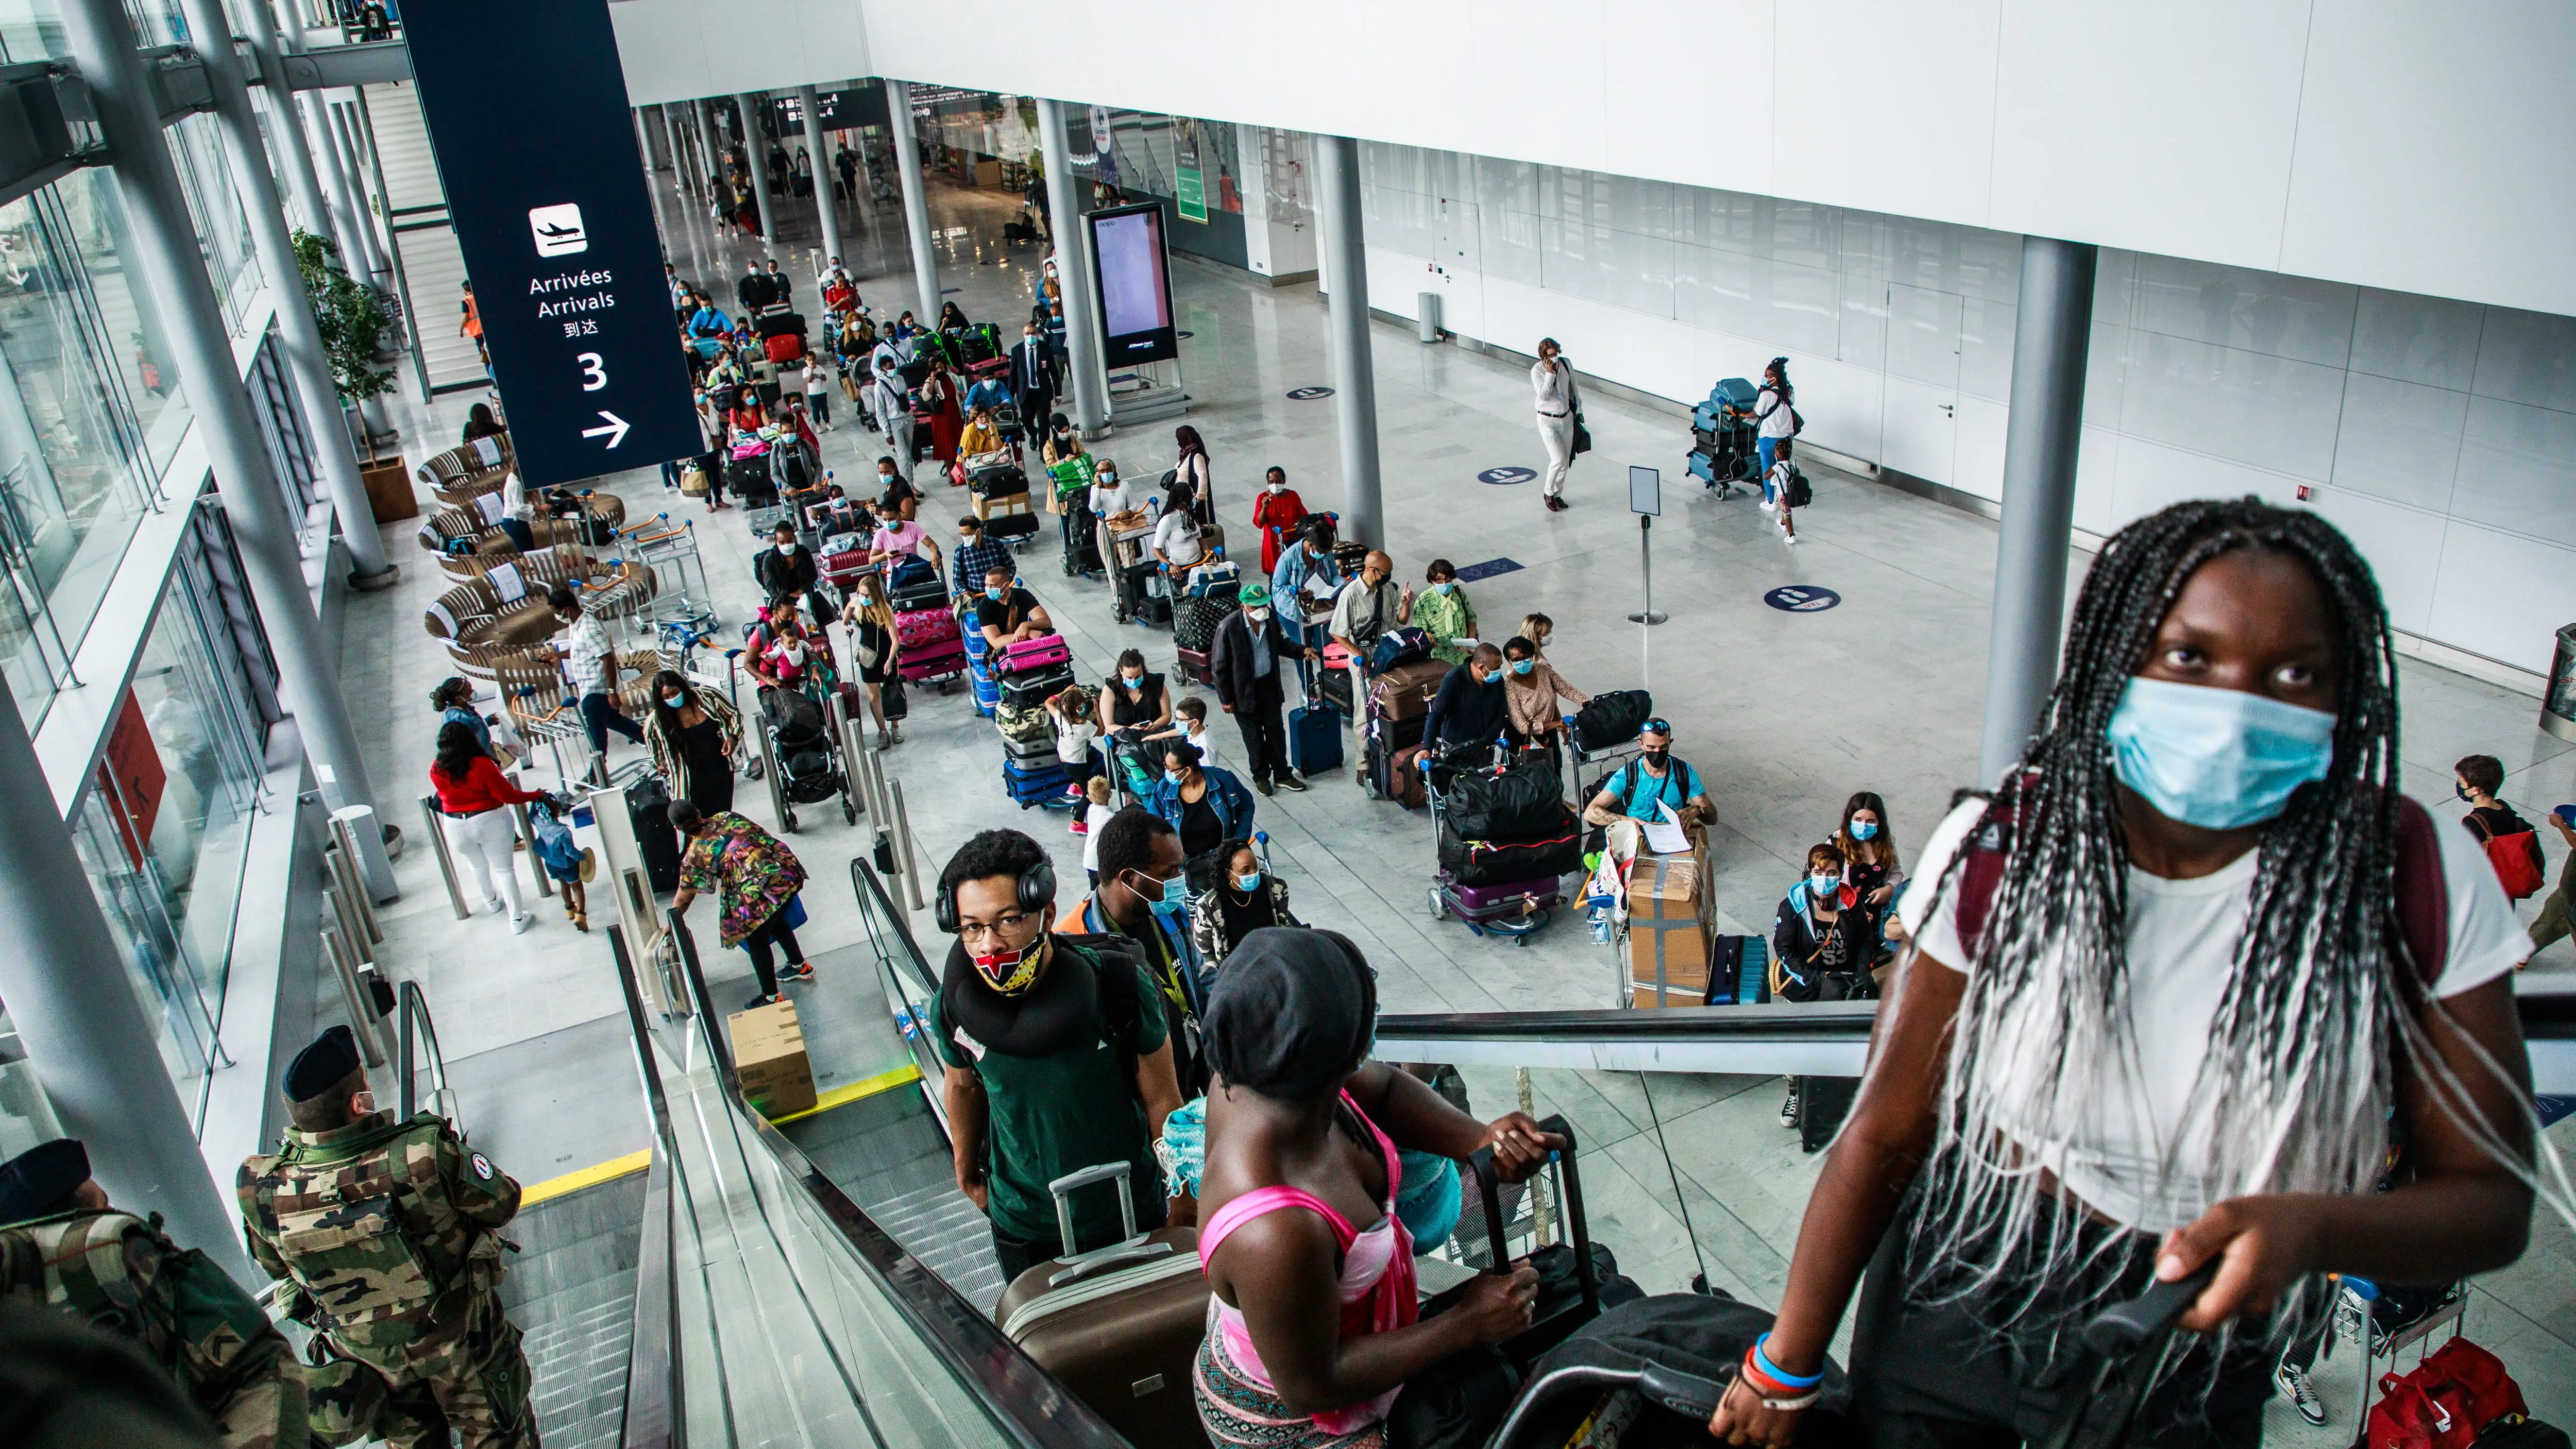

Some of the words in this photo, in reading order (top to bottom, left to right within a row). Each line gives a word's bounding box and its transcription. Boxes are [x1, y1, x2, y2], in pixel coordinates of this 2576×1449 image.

[831, 93, 839, 103] 4
[826, 107, 834, 116] 4
[530, 269, 613, 295] Arrivées
[538, 291, 615, 318] Arrivals
[563, 319, 598, 338] 到达
[577, 352, 607, 391] 3
